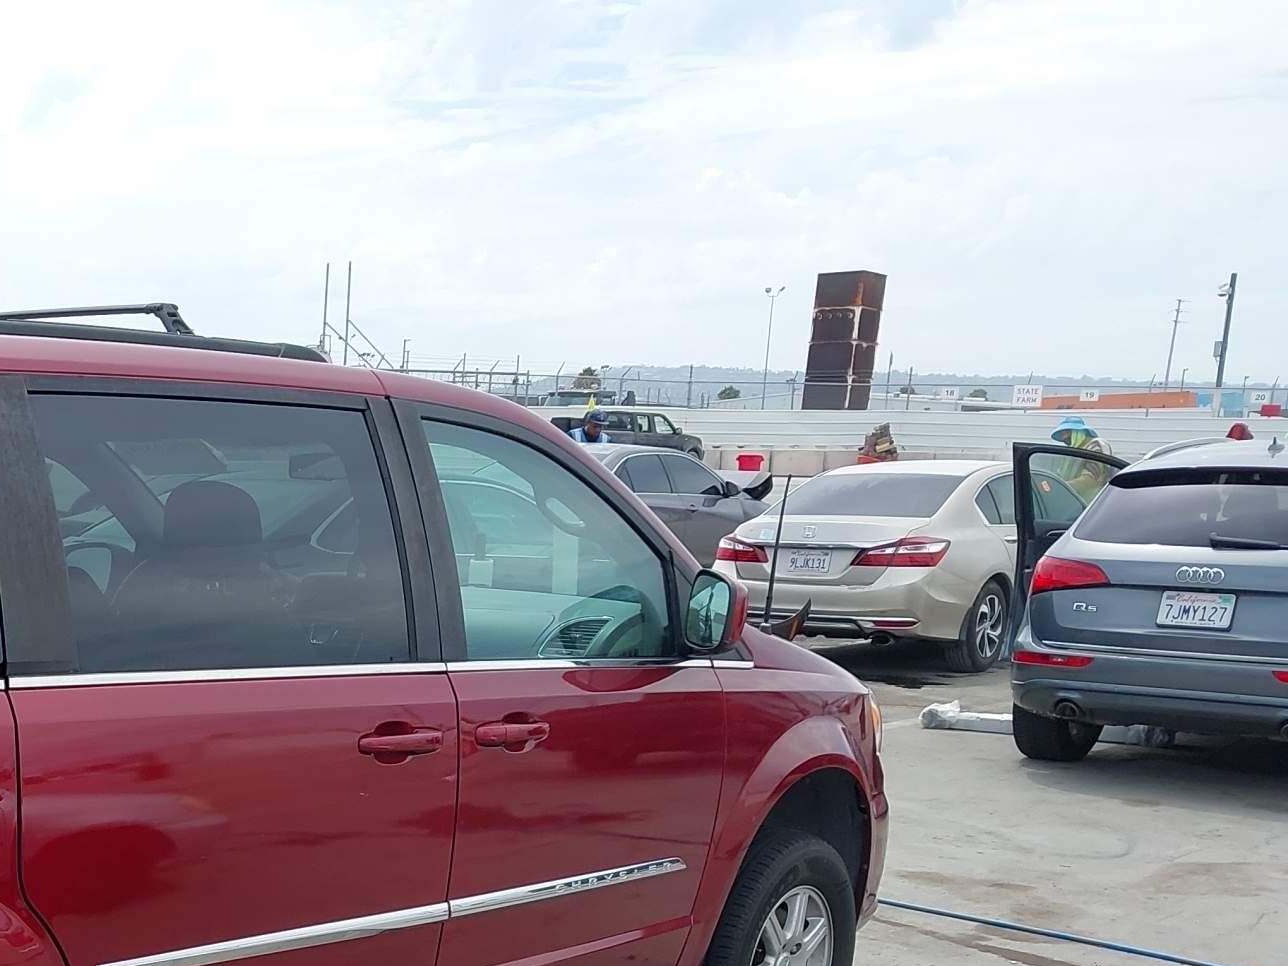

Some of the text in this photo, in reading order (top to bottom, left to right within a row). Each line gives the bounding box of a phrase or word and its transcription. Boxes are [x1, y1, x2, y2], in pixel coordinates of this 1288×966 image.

[1085, 391, 1095, 399] 19
[790, 557, 827, 569] 9LJK131
[1073, 602, 1097, 612] Q5
[1165, 604, 1228, 623] 7JMY127
